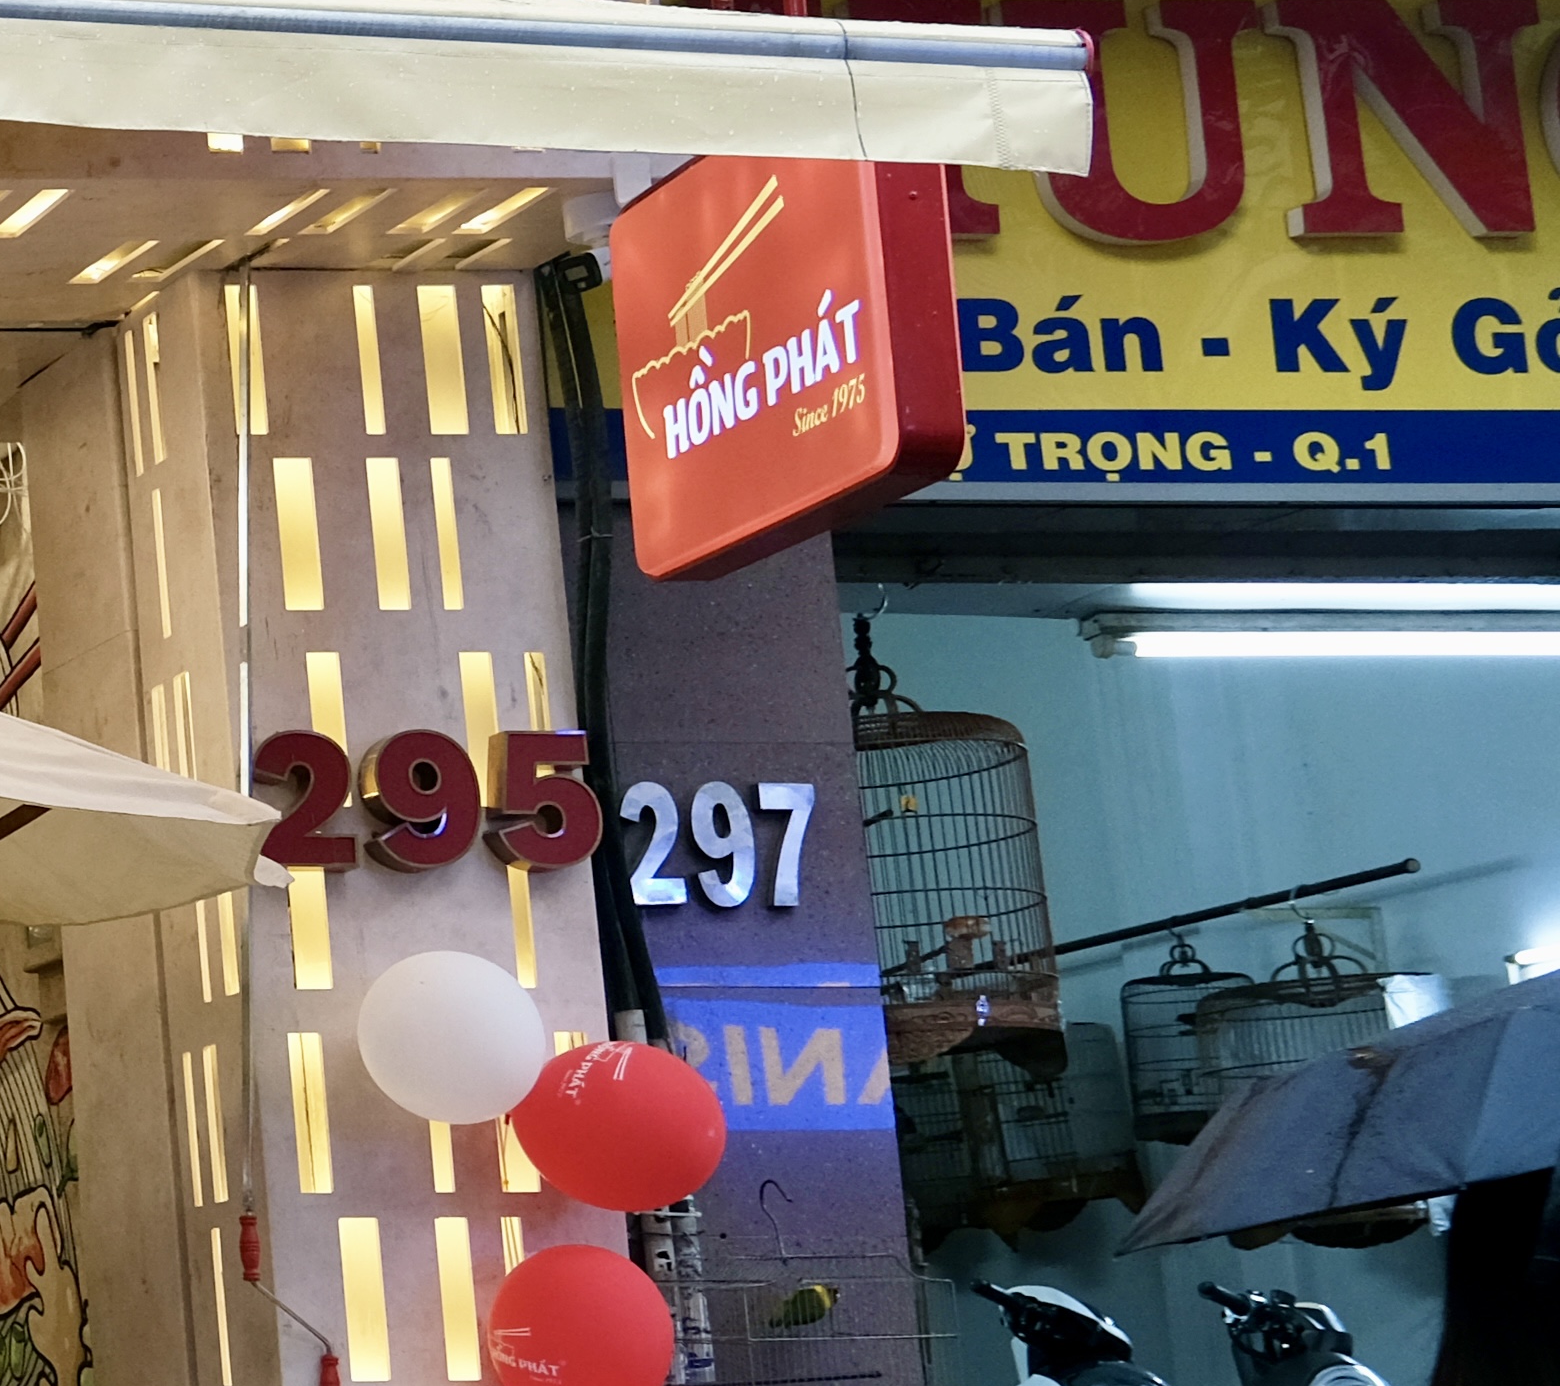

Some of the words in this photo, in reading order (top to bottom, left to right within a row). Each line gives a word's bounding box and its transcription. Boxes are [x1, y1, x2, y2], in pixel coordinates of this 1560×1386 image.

[663, 345, 759, 459] HỒNG
[762, 288, 861, 407] PHÁT
[957, 295, 1165, 374] Bán
[1268, 296, 1408, 391] Ký
[792, 404, 829, 437] Since
[831, 373, 866, 419] 1975
[995, 431, 1233, 481] TRỌNG
[1292, 430, 1392, 474] Q.1
[254, 729, 603, 871] 295
[620, 780, 815, 907] 297
